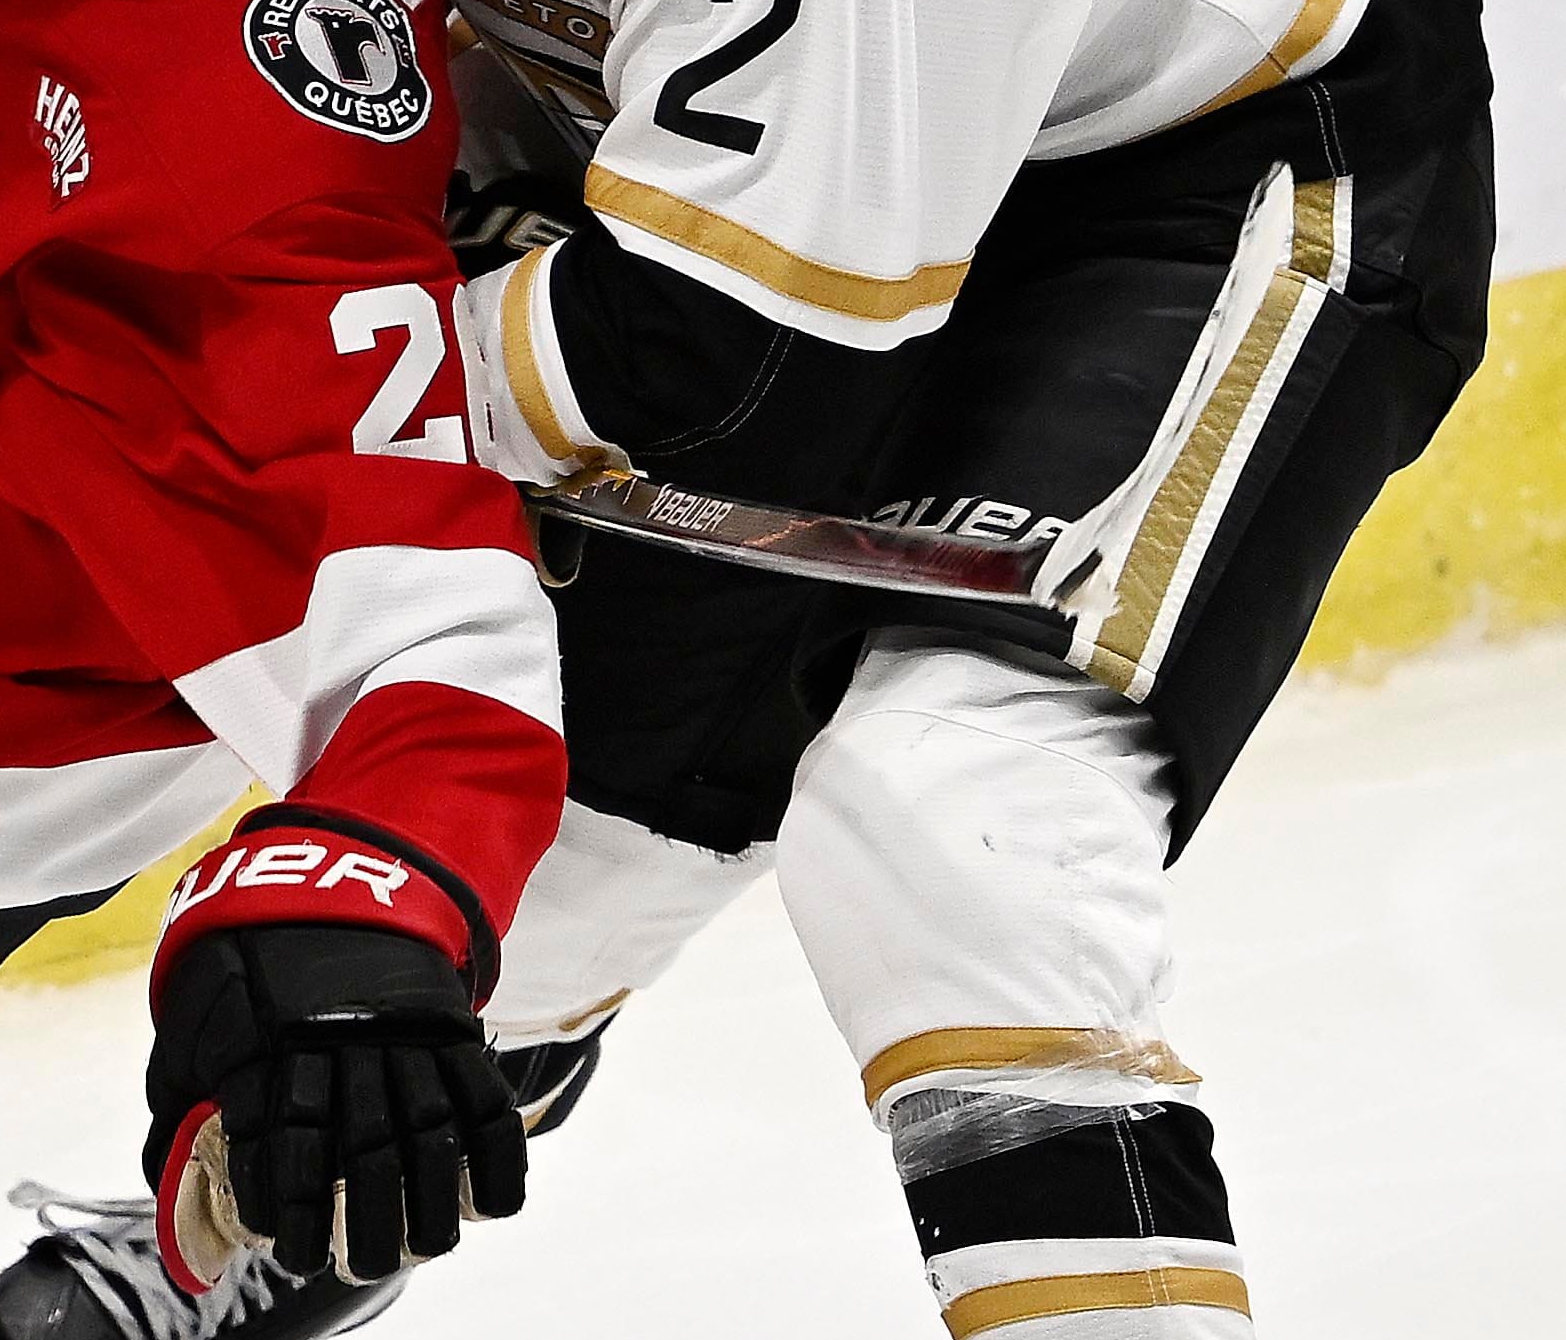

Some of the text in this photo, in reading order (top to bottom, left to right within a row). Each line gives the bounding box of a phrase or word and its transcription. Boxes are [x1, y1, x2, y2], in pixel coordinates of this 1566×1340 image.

[35, 75, 91, 198] HEINZ
[303, 81, 420, 129] QUÉBEC
[652, 489, 735, 533] BAUER
[156, 841, 411, 949] UER
